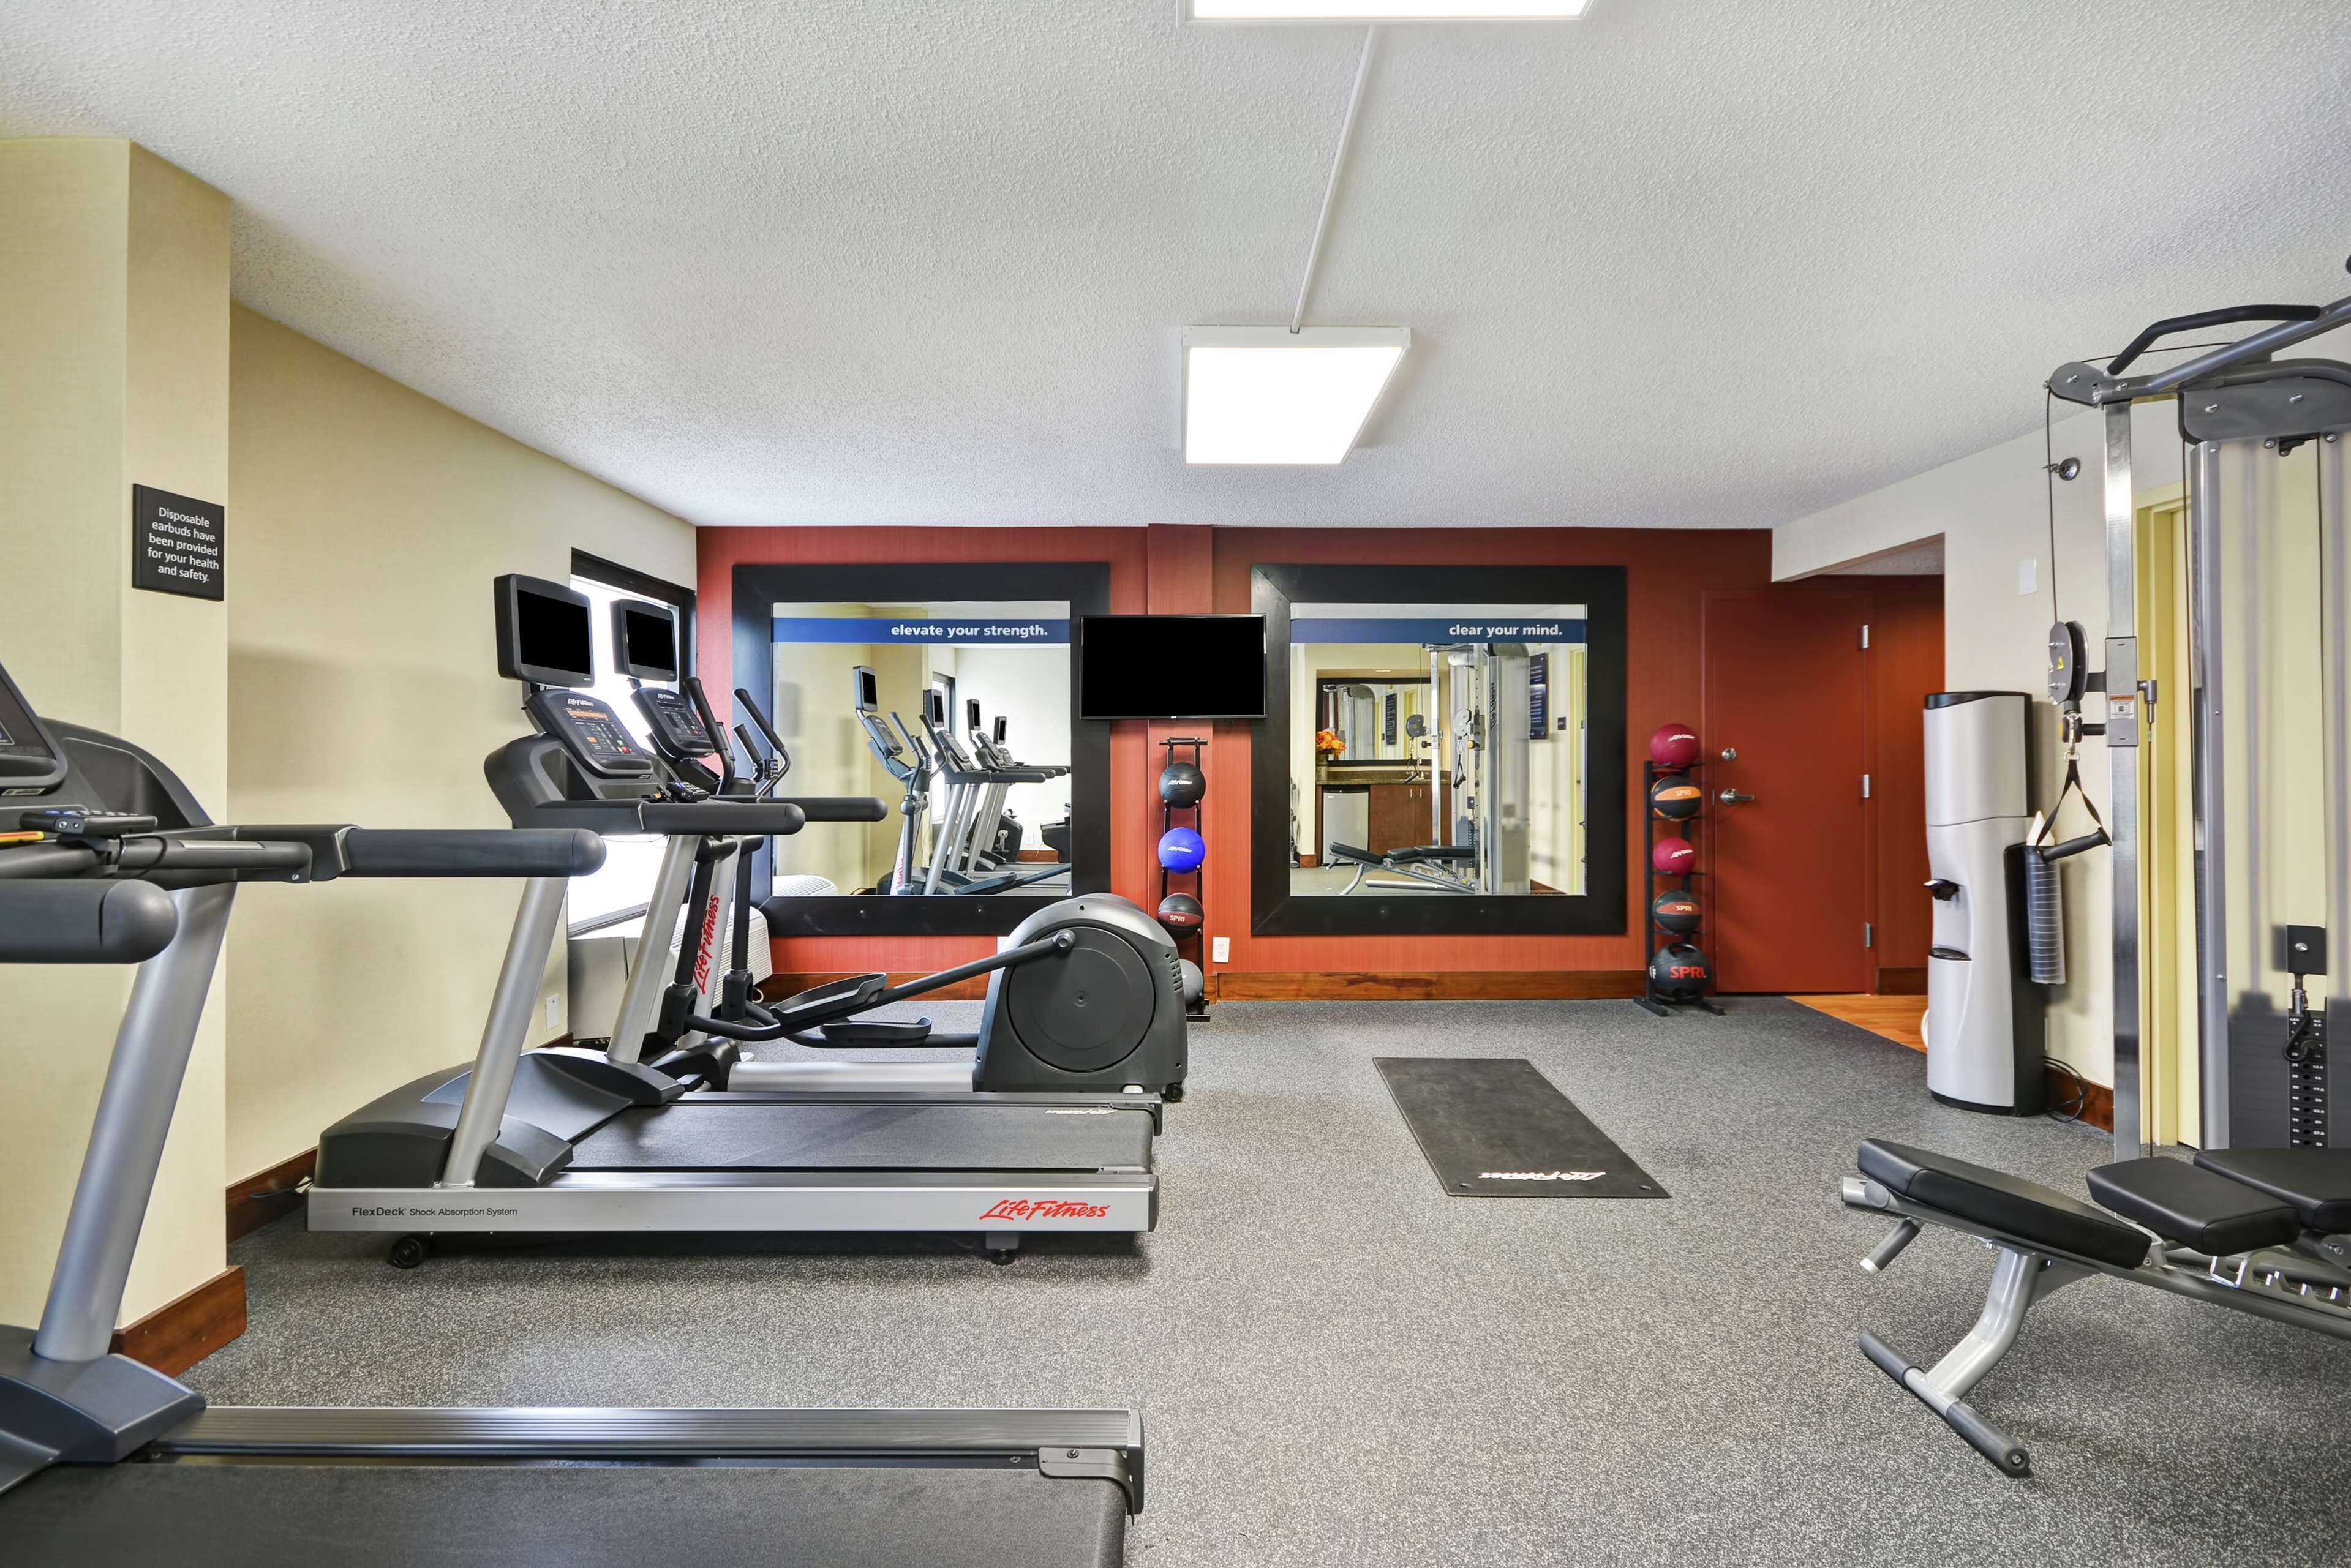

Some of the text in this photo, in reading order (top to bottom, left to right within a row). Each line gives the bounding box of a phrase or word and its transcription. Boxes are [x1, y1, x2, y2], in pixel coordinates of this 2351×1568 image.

[159, 507, 210, 527] Disposable
[152, 522, 216, 542] earbuds have
[149, 533, 218, 556] been provided
[147, 547, 219, 570] for your health
[157, 565, 209, 583] and safety.
[891, 624, 1048, 639] elevate your strength.
[1448, 624, 1563, 638] clear your mind.
[1670, 966, 1706, 978] SPRI
[352, 1207, 405, 1216] FlexDeck
[438, 1207, 484, 1217] Absorption
[486, 1207, 518, 1217] System
